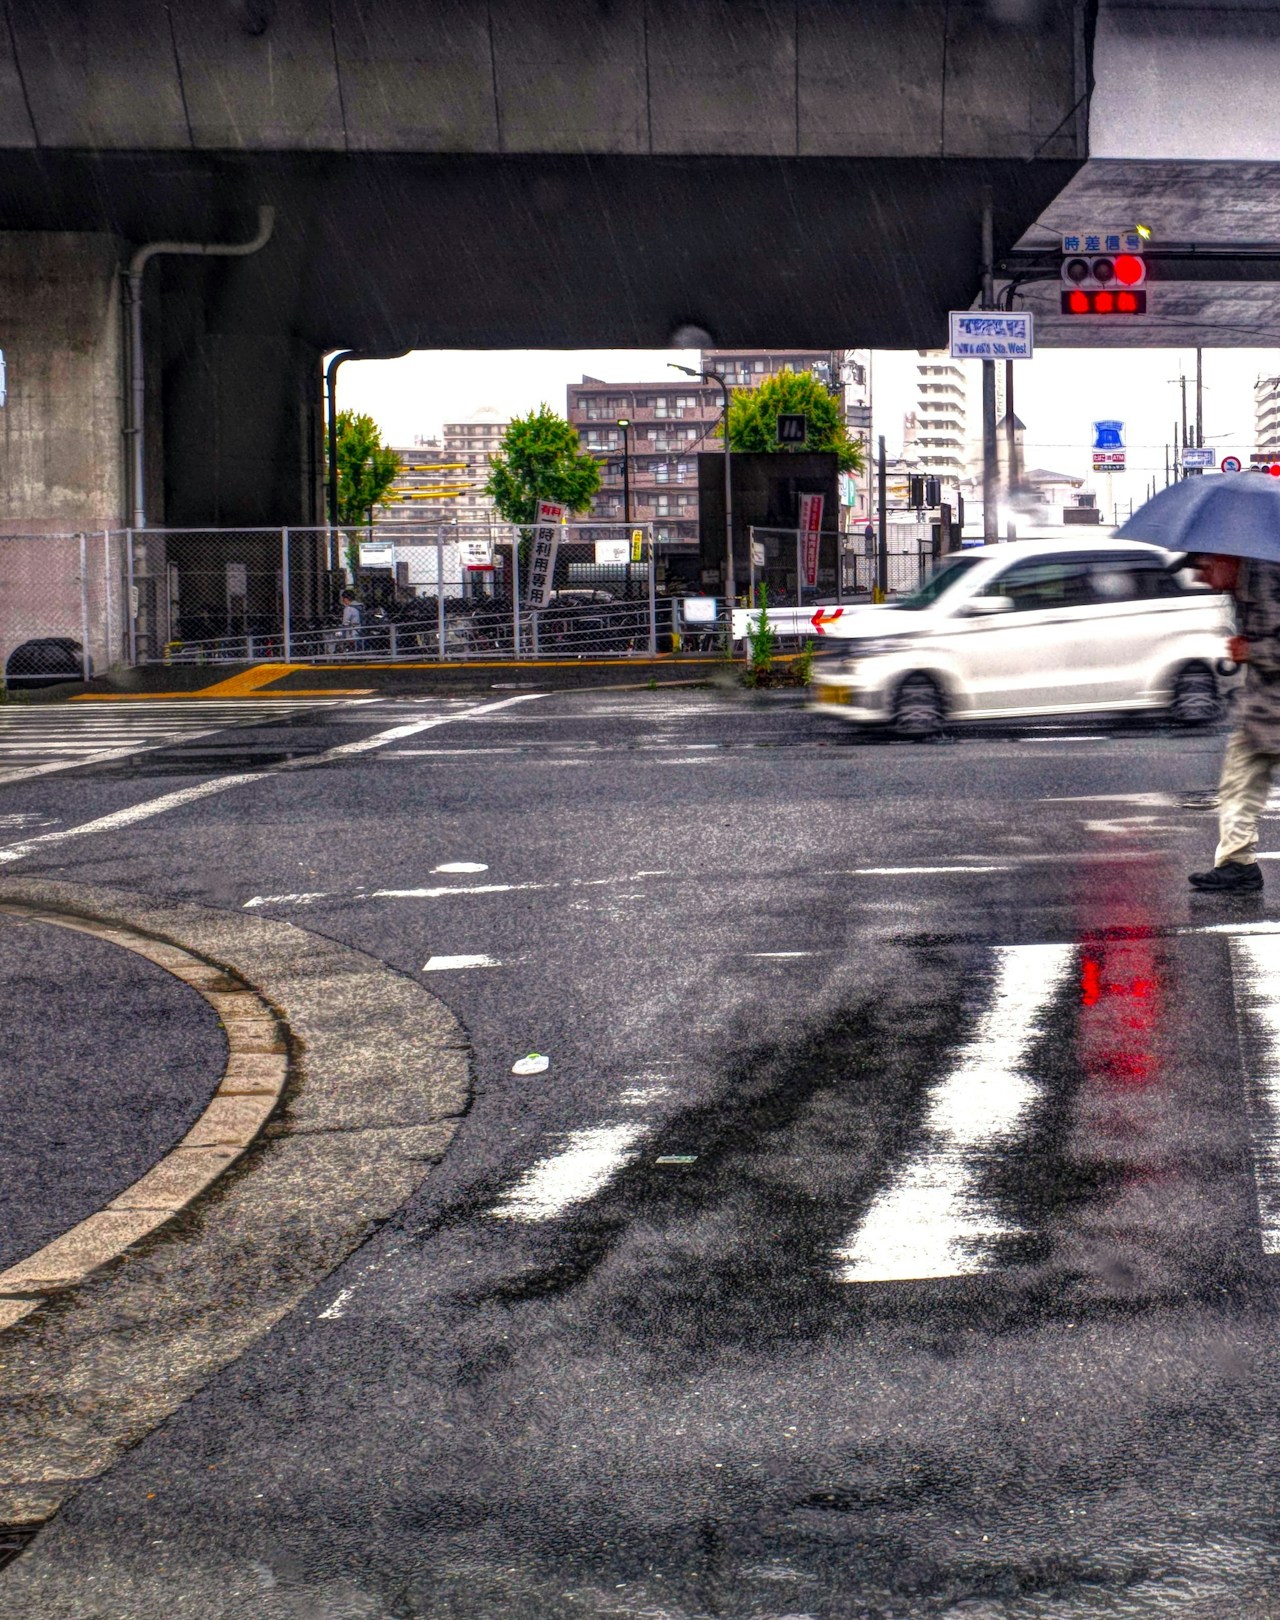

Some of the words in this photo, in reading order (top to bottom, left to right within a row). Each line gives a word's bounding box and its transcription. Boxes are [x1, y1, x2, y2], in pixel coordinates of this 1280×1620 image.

[1064, 235, 1140, 251] 時差信号
[1008, 342, 1027, 354] West
[541, 504, 561, 518] 有料
[530, 518, 557, 604] 一時利用専用
